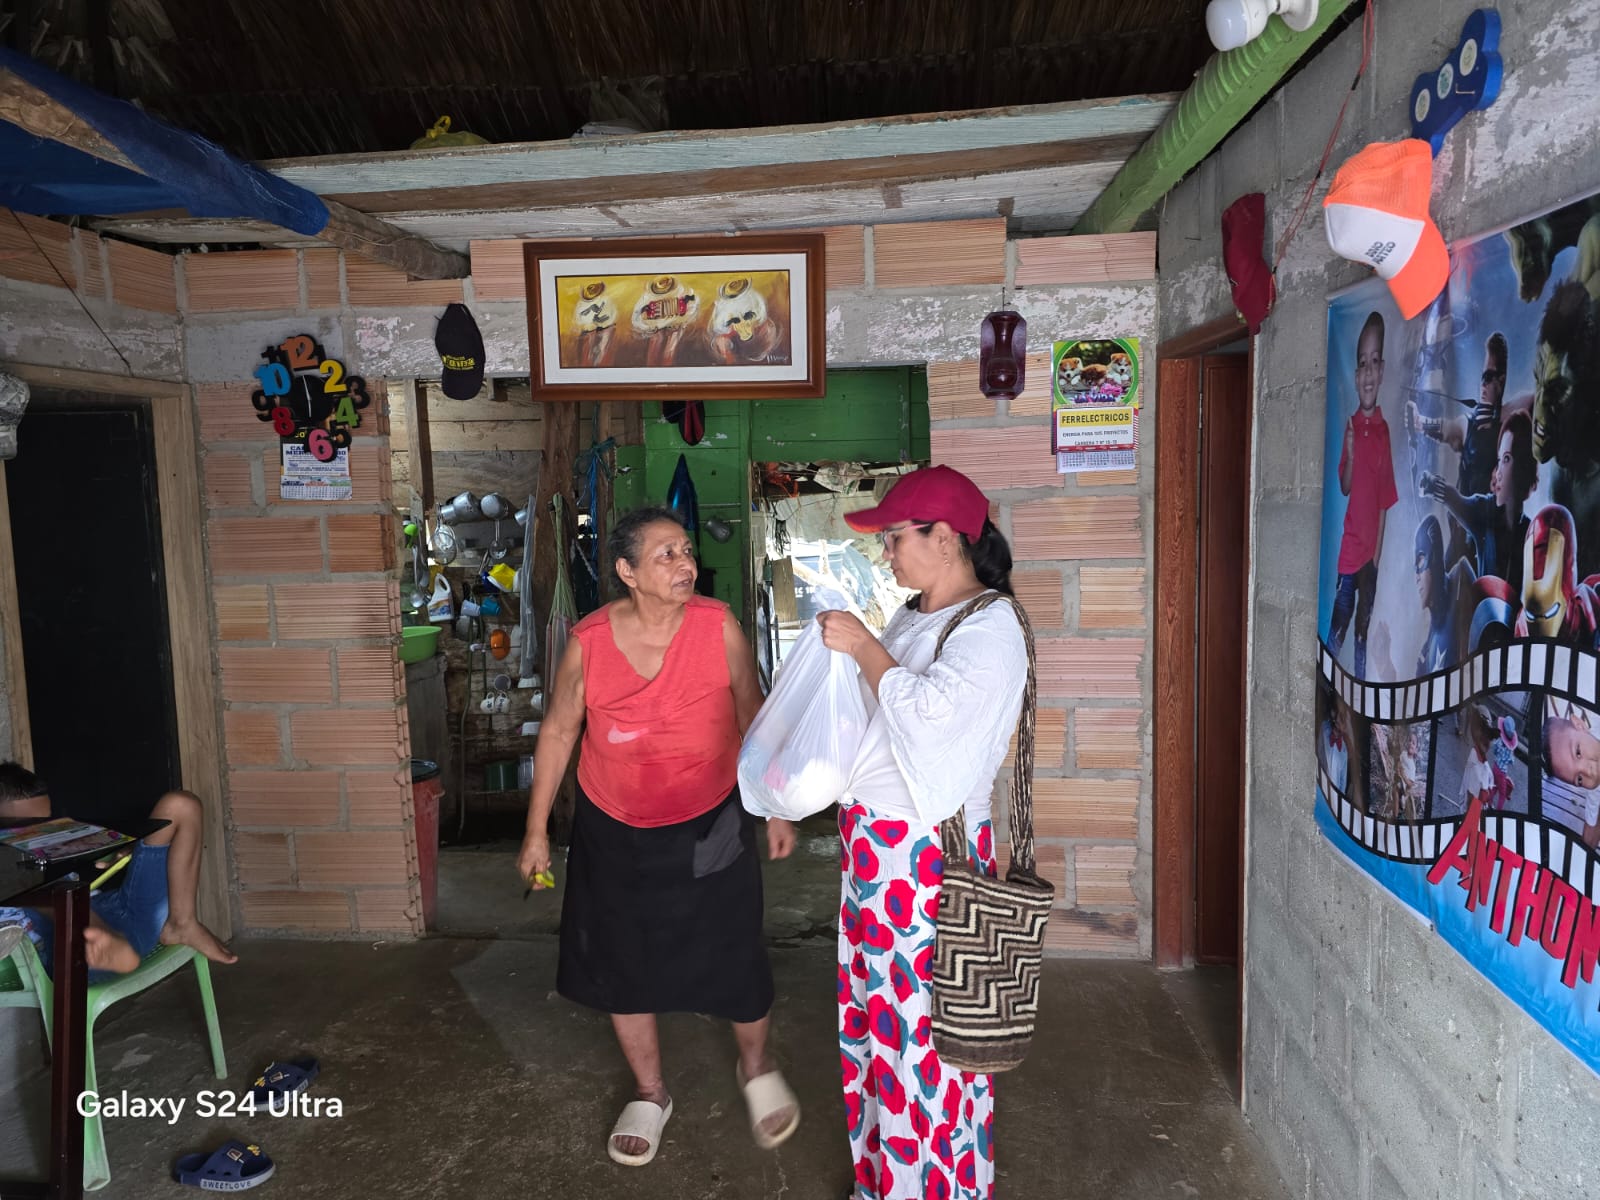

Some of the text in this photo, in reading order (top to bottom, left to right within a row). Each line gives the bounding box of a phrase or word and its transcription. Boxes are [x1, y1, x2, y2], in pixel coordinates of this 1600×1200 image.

[281, 335, 319, 369] 12
[253, 362, 292, 396] 10
[320, 360, 348, 393] 2
[272, 406, 296, 436] 8
[336, 397, 359, 427] 4
[1062, 413, 1129, 424] FERRELECTRICOS
[308, 428, 334, 461] 6
[1427, 796, 1600, 989] ANTHON
